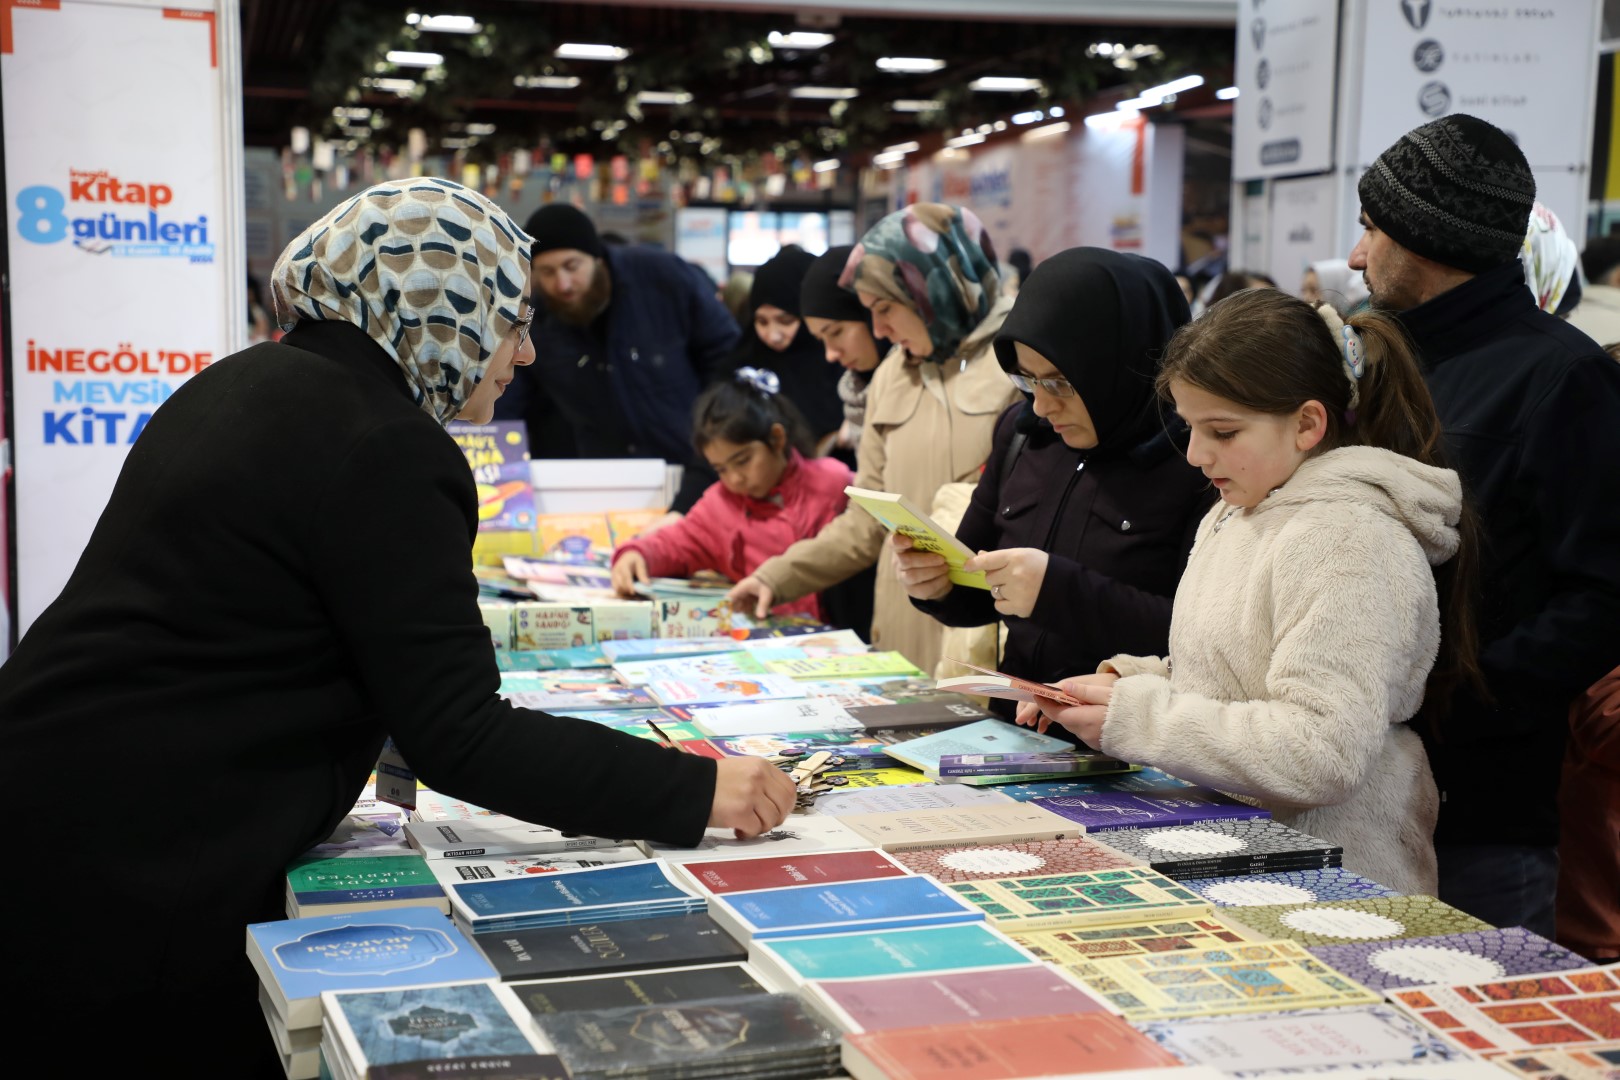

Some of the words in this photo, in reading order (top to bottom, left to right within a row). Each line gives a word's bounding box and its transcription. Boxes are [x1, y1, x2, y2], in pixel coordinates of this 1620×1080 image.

[16, 185, 69, 244] 8
[73, 211, 207, 245] günleri
[27, 339, 212, 374] İNEGÖL'DE
